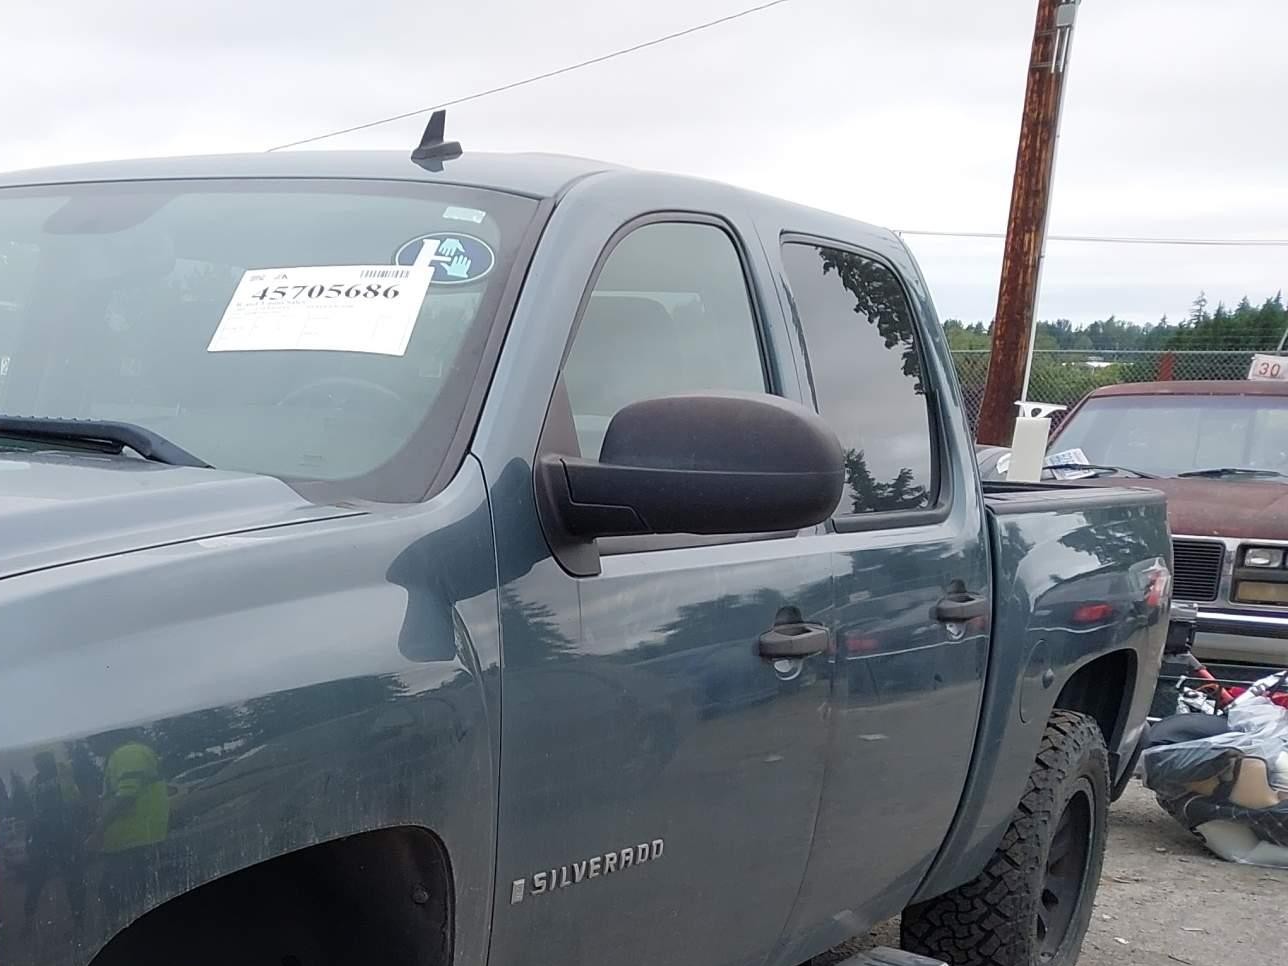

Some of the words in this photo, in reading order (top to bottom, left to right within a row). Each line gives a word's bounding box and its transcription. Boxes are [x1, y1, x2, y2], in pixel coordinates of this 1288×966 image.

[251, 284, 400, 301] 45705686
[1258, 361, 1281, 377] 30
[530, 838, 664, 895] SILVERADO
